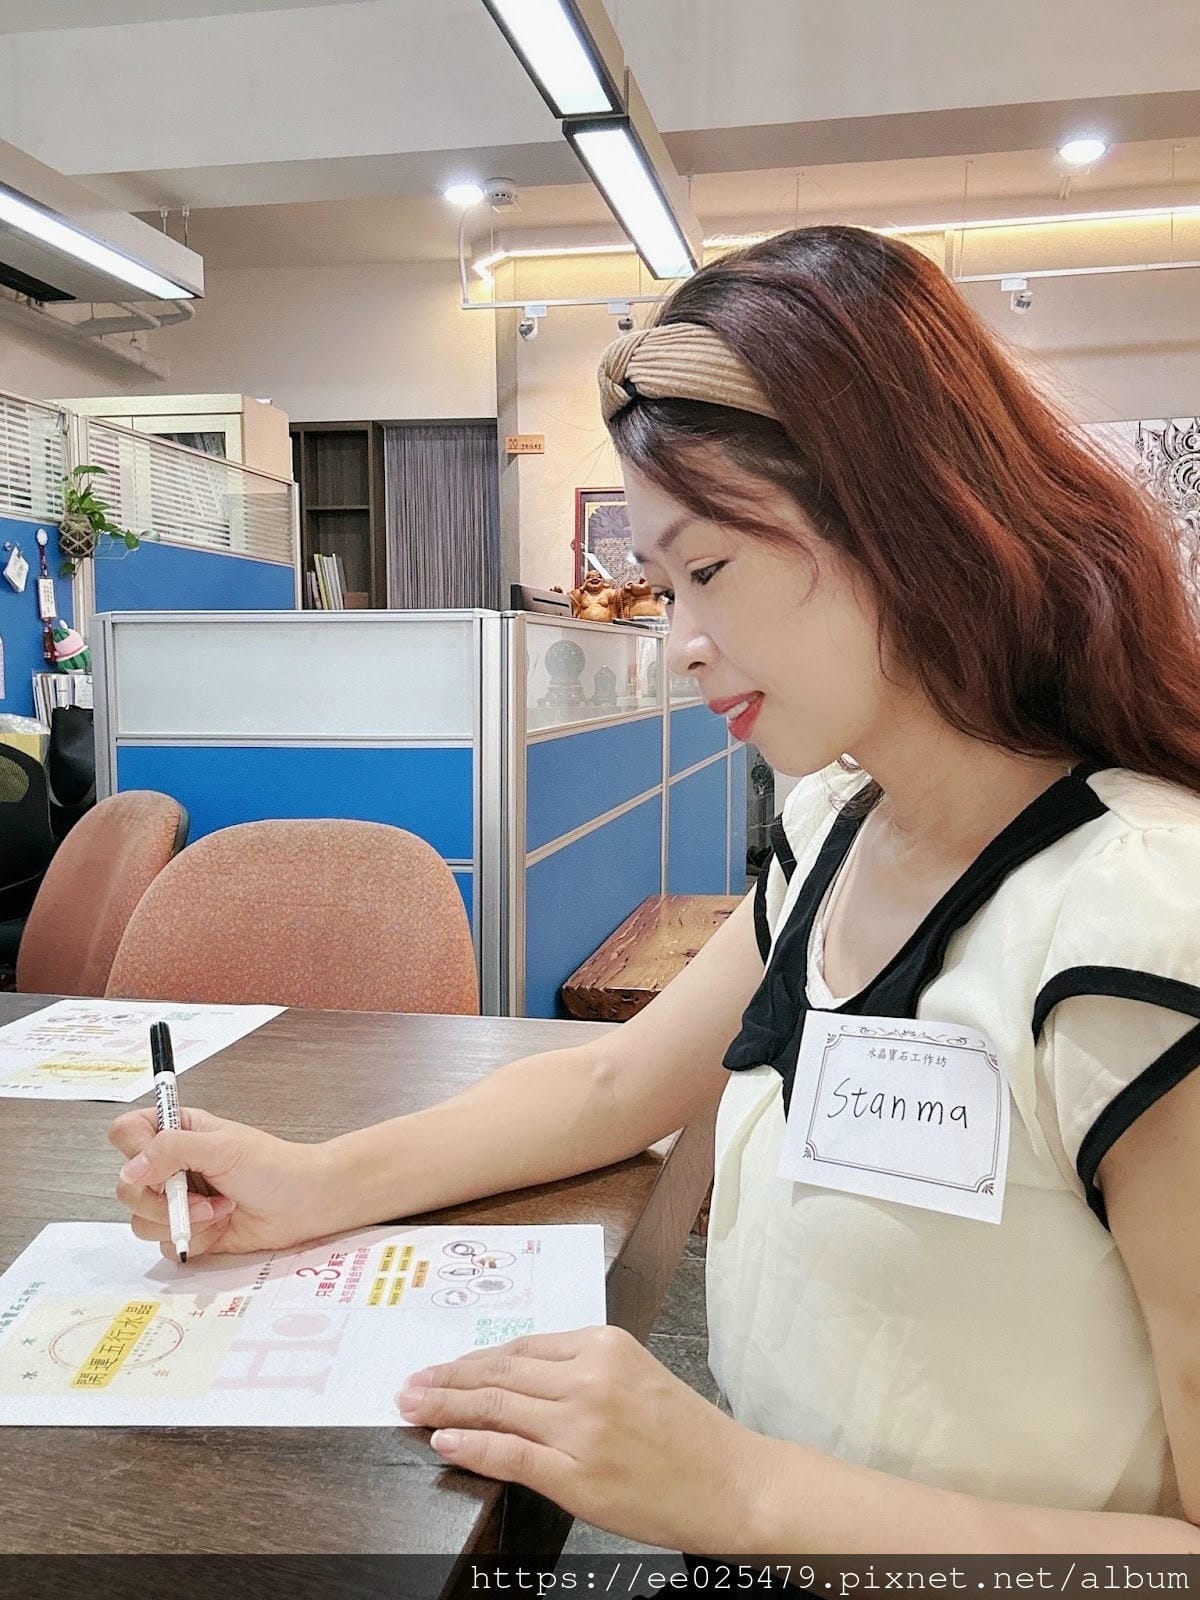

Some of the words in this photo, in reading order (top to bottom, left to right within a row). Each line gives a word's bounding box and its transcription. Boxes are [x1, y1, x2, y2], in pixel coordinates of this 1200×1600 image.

[866, 1047, 948, 1067] 水晶寶石工作坊
[75, 1303, 155, 1387] 開運五行水晶
